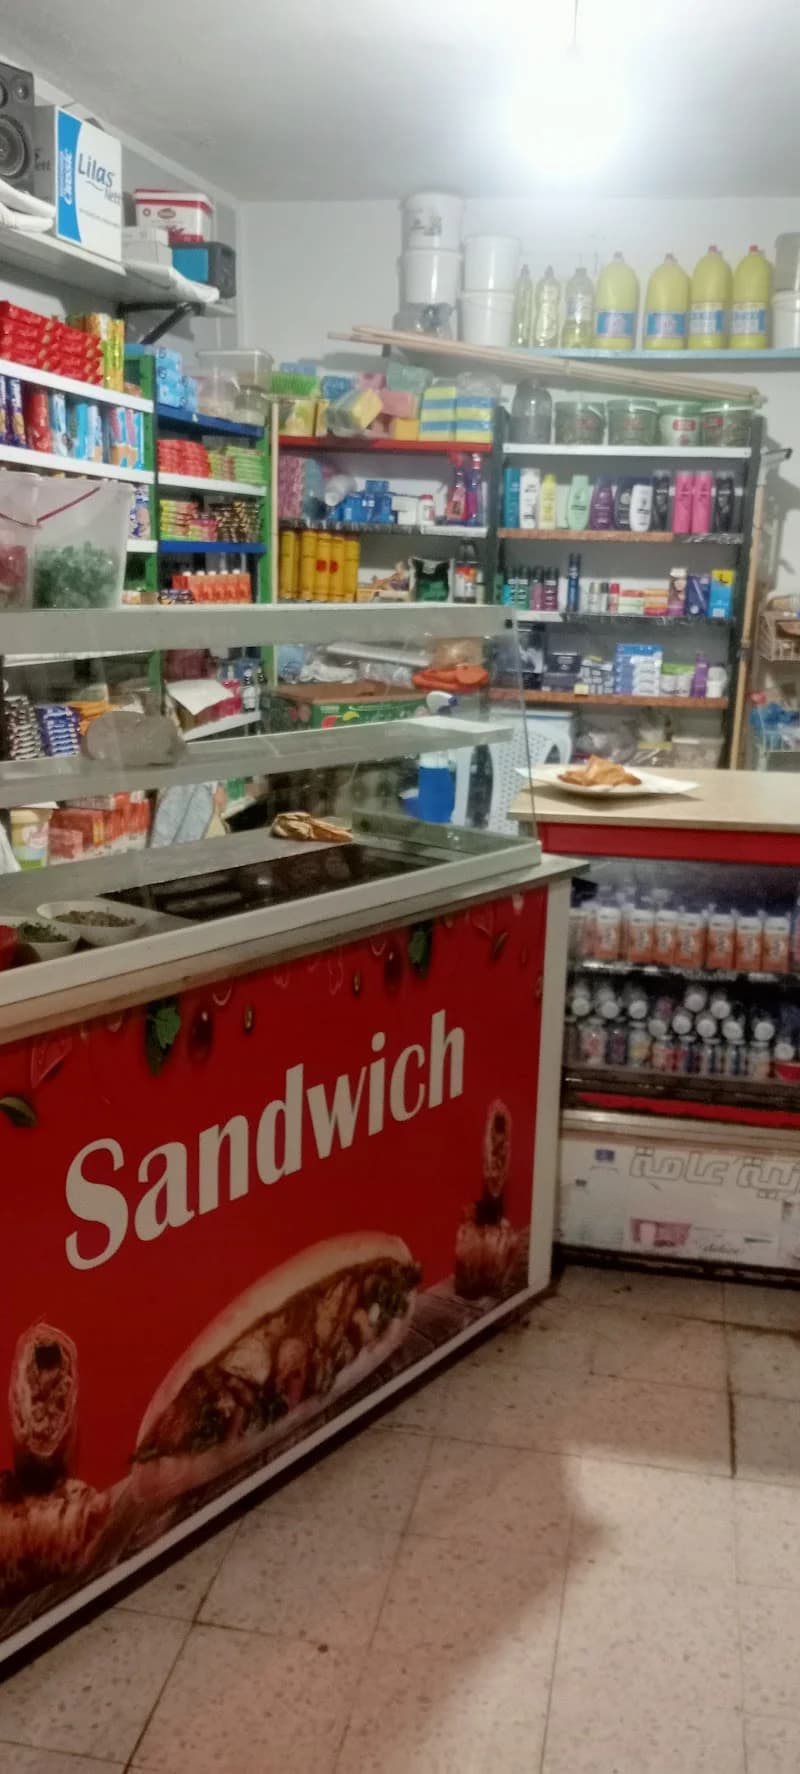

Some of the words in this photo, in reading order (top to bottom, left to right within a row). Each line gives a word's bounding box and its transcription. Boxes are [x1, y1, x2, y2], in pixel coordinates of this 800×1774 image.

[77, 153, 115, 188] Lilas
[65, 1009, 465, 1270] Sandwich
[629, 1146, 730, 1186] عامة
